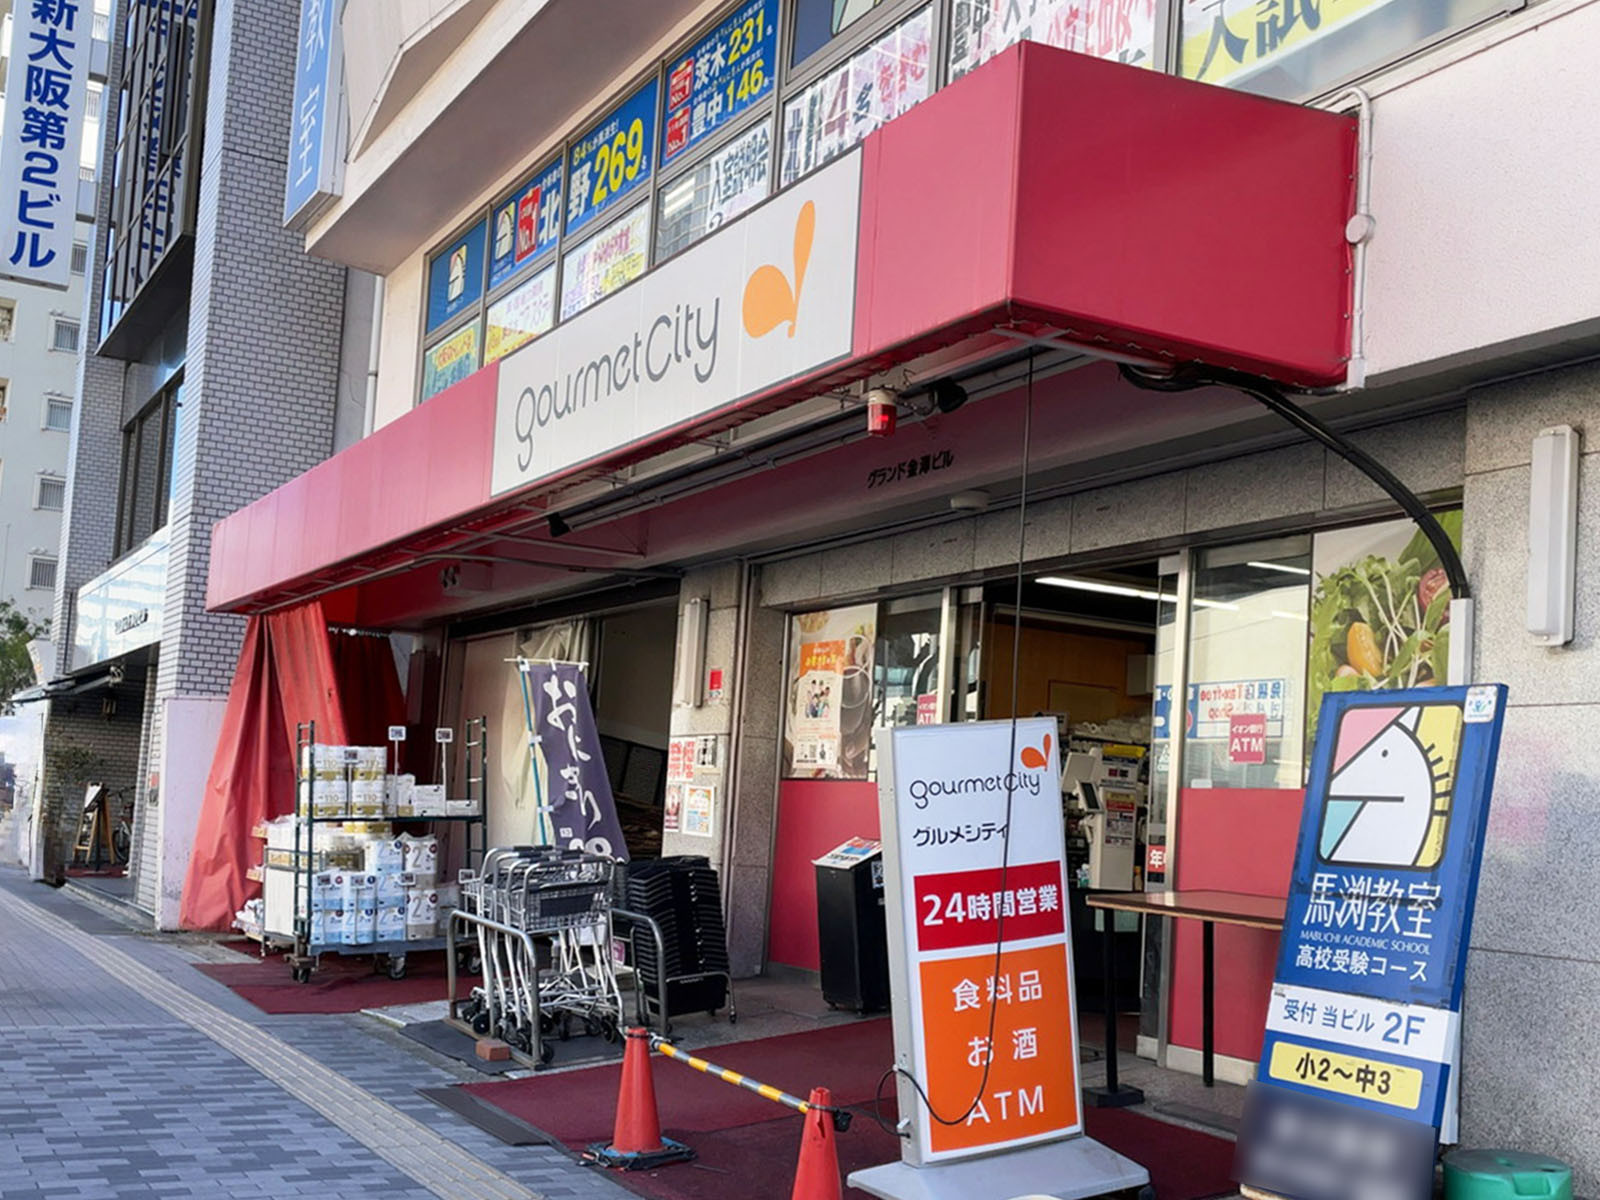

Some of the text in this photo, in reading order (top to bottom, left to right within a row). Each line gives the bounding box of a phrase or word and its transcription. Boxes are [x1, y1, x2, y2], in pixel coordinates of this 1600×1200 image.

[9, 0, 79, 269] 新大阪第2ビル
[543, 674, 602, 831] おにぎり
[1230, 737, 1264, 753] ATM
[912, 822, 1009, 848] グルメシティ
[922, 883, 1060, 927] 24時間営業
[1302, 872, 1442, 939] 馬渕教室
[1295, 944, 1428, 982] 高校受験コース
[1299, 929, 1431, 956] MABUCHI ACADEMIC SCHOOL
[952, 969, 1043, 1012] 食料品
[1283, 999, 1426, 1046] 受付 当ビル 2F
[966, 1085, 1045, 1127] ATM
